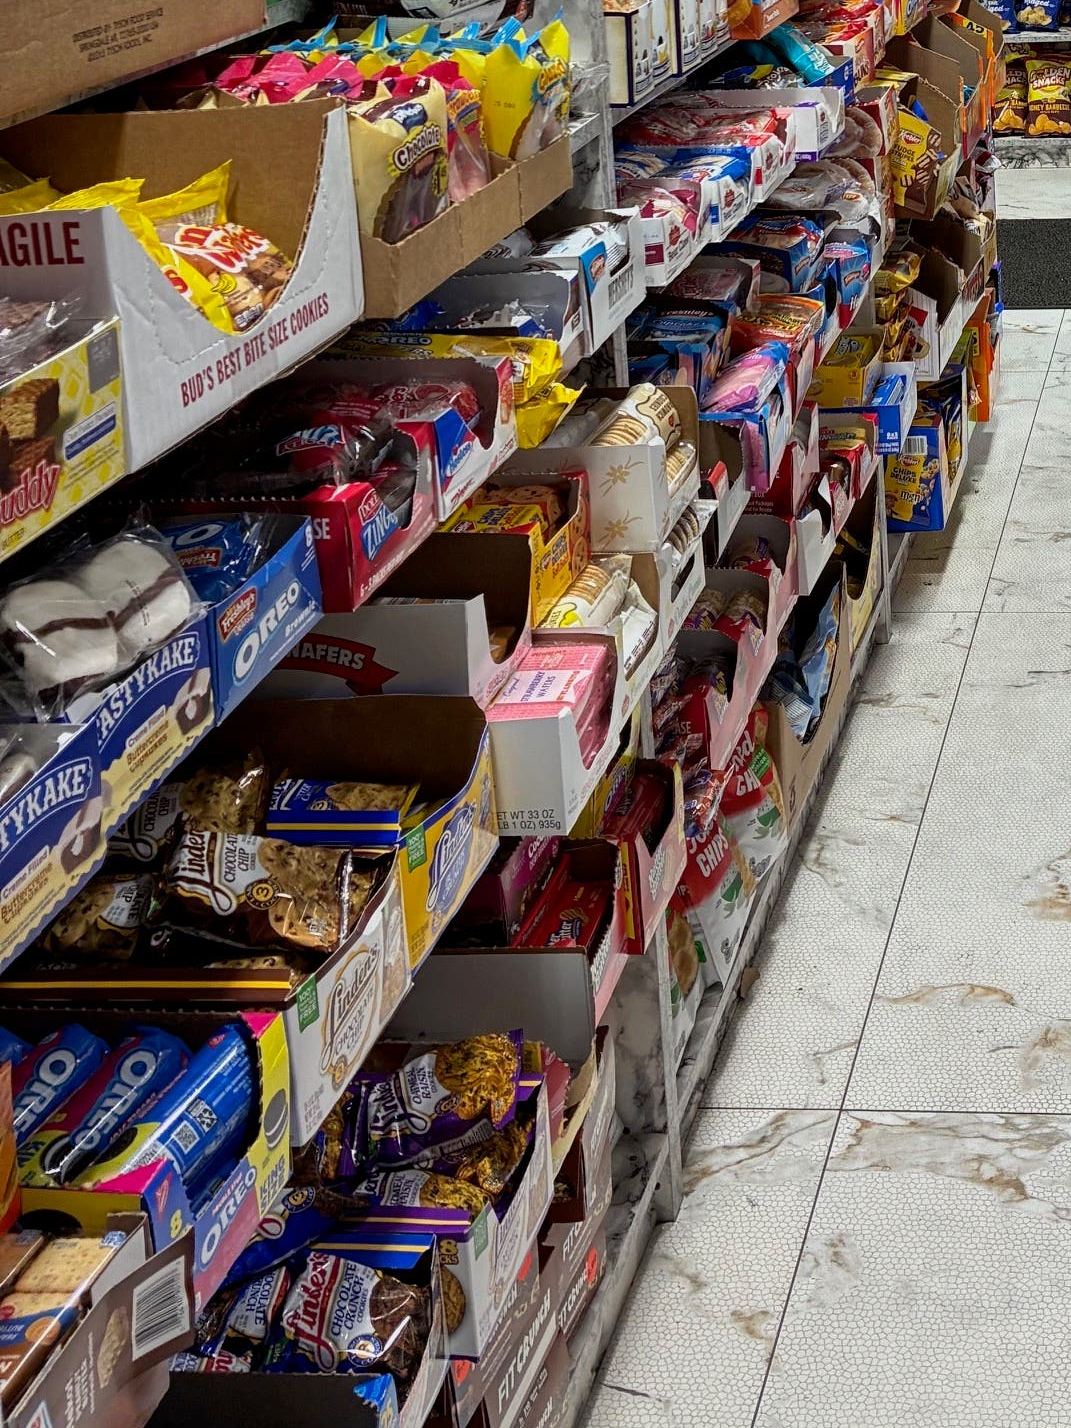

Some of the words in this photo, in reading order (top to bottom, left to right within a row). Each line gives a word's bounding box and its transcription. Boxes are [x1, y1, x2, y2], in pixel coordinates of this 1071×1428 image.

[394, 127, 441, 169] Chocolate
[181, 367, 215, 408] BUD'S
[216, 353, 242, 384] BEST
[244, 338, 267, 367] BITE
[268, 323, 289, 350] SIZE
[290, 292, 330, 335] COOKIES
[234, 580, 300, 682] OREO
[521, 672, 546, 703] STRAWBERRY
[536, 674, 556, 701] WAFERS
[126, 722, 169, 764] Buttercreme
[127, 728, 146, 748] Creme
[147, 713, 165, 732] Filled
[129, 734, 168, 772] Cupcakes
[510, 811, 525, 821] WT
[528, 810, 540, 820] 33
[542, 810, 555, 820] OZ
[519, 821, 535, 832] OZ)
[538, 820, 561, 832] 935g
[238, 848, 250, 872] CHIP
[3, 873, 27, 899] Creme
[71, 1048, 157, 1150] OREO
[260, 1154, 285, 1198] KING
[200, 1166, 257, 1265] OREO
[331, 1263, 357, 1337] CHOCOLATE
[344, 1274, 365, 1332] CRUNCH
[356, 1288, 369, 1324] COOKIES
[498, 1372, 517, 1414] FIT
[516, 1288, 552, 1374] CRUNCH
